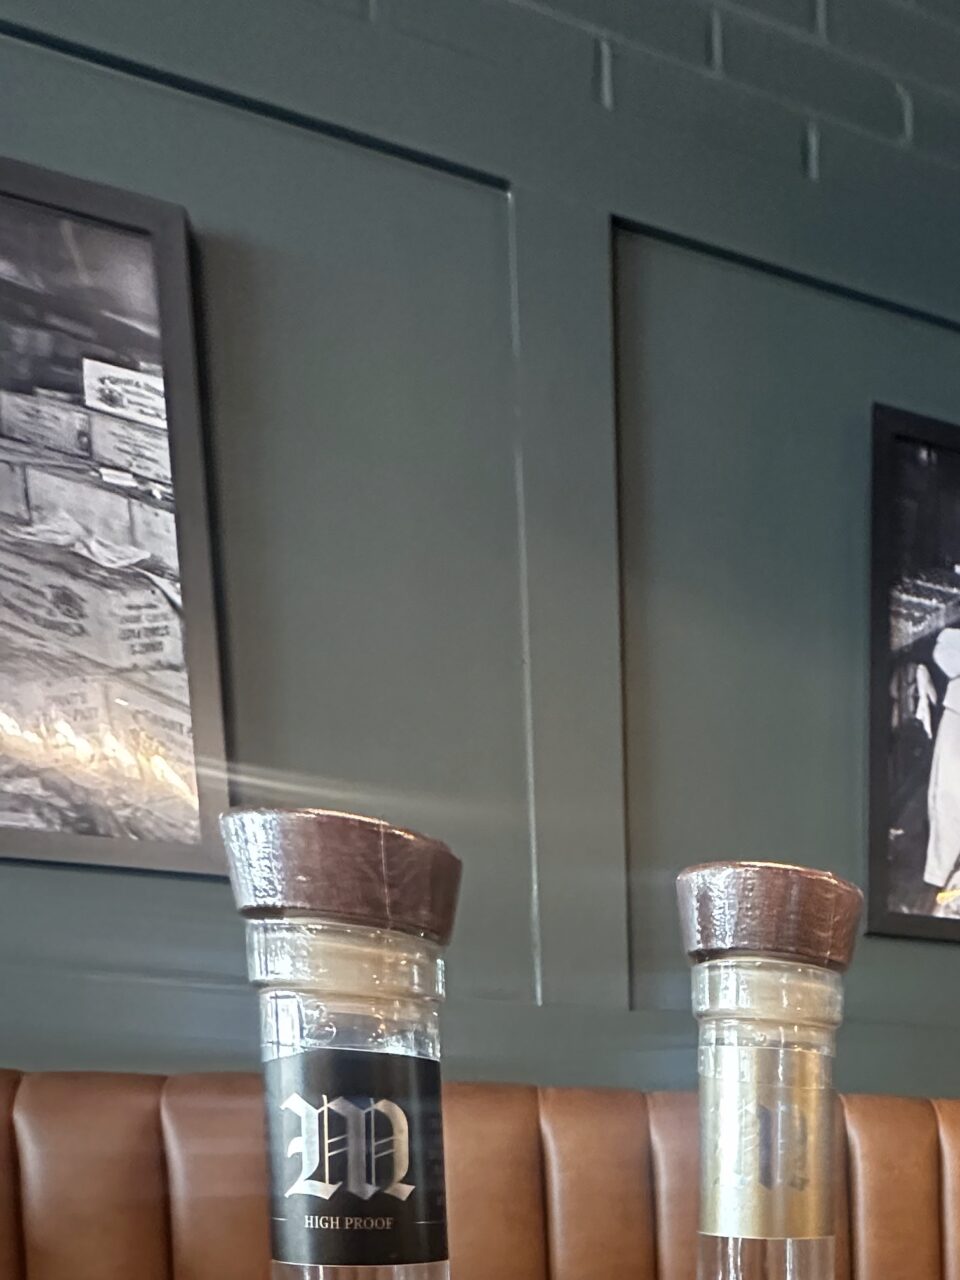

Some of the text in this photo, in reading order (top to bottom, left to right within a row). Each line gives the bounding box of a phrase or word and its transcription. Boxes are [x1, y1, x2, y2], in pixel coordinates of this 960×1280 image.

[280, 1092, 416, 1201] M
[304, 1215, 394, 1231] HIGH PROOF
